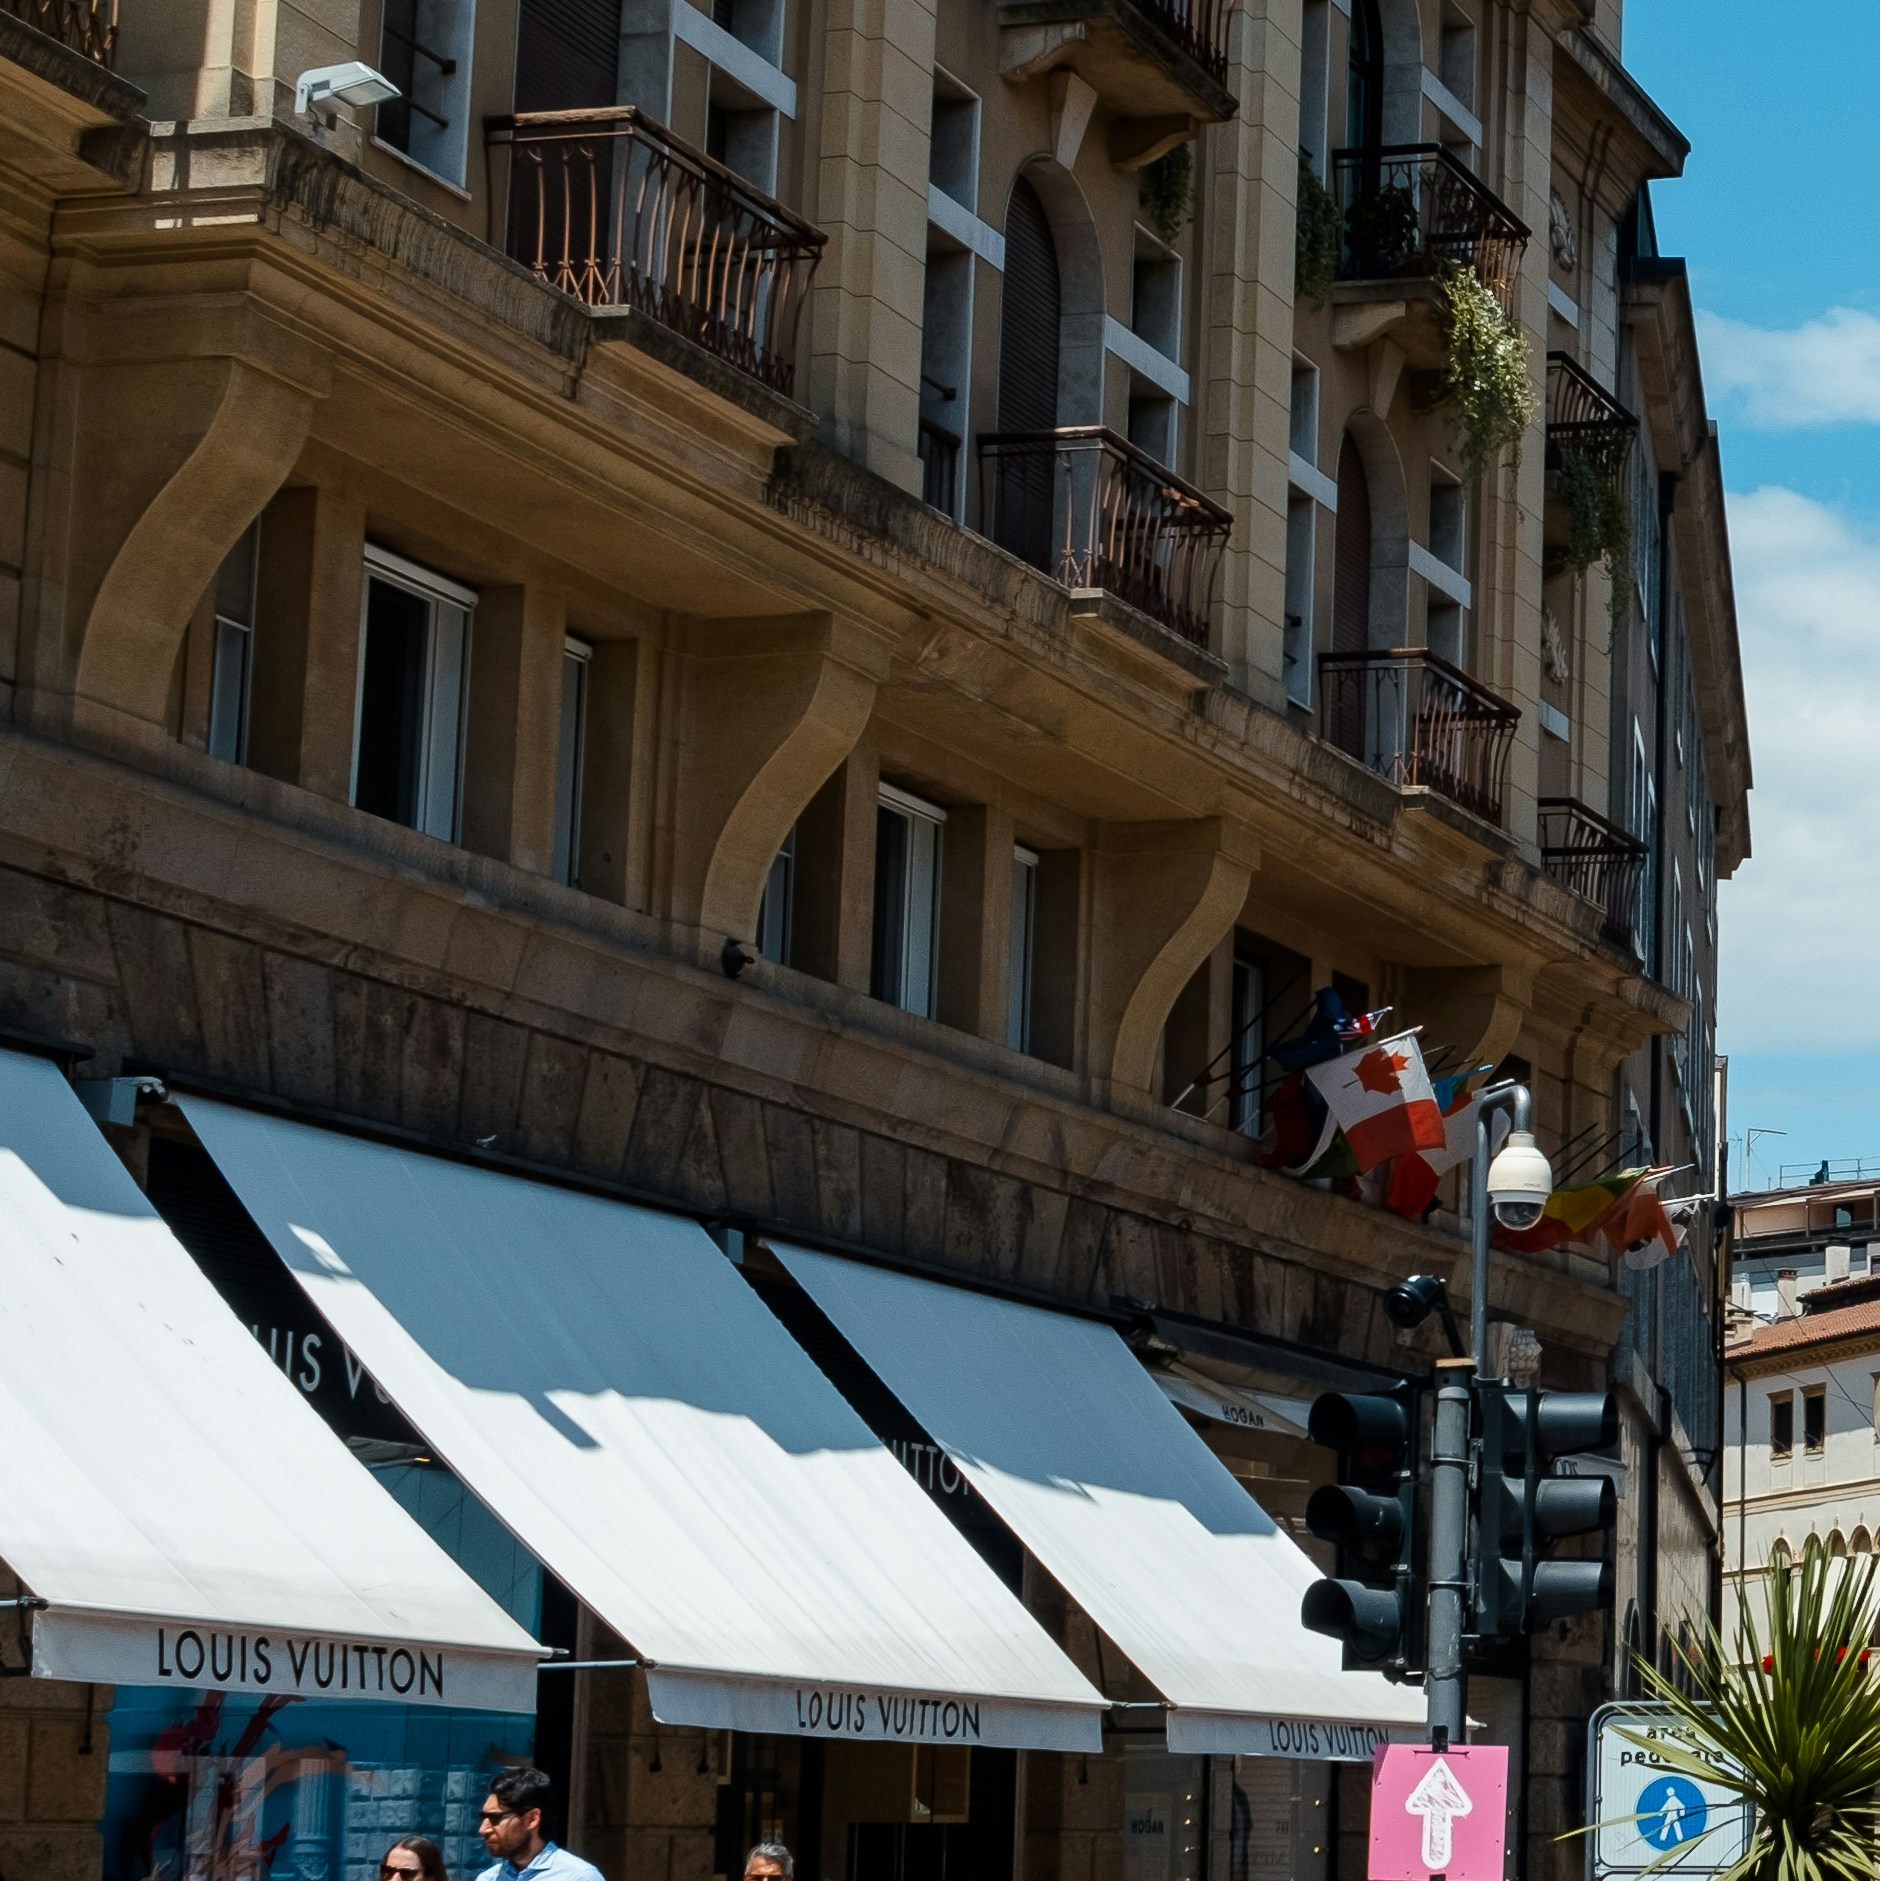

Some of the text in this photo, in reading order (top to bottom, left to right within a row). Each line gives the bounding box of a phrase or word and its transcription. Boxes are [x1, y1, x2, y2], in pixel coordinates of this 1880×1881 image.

[1222, 1405, 1264, 1428] HOGAN
[158, 1628, 443, 1698] LOUIS VUITTON
[796, 1689, 981, 1740] LOUIS VUITTON
[1268, 1721, 1320, 1754] LOUIS
